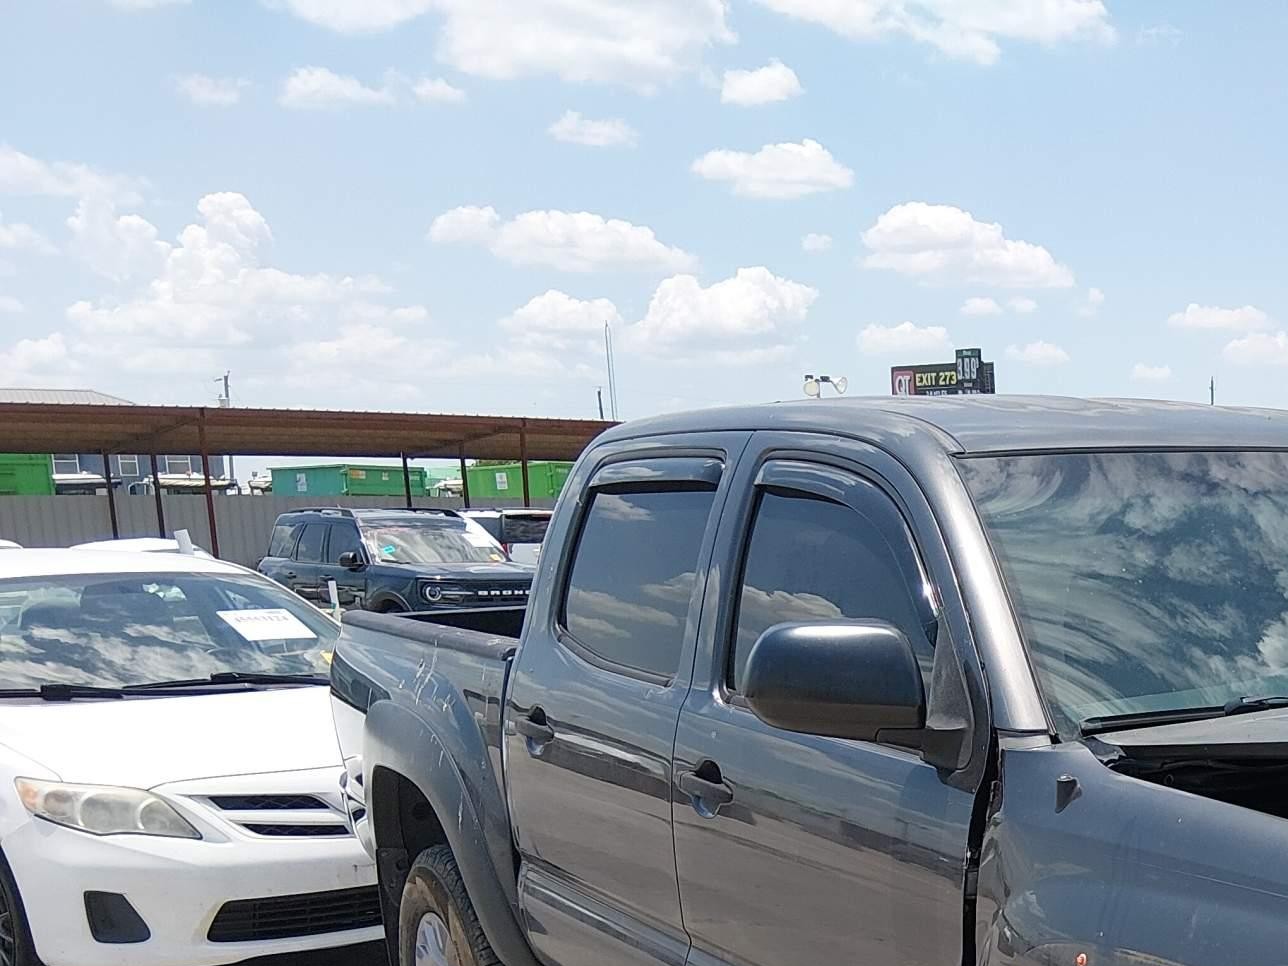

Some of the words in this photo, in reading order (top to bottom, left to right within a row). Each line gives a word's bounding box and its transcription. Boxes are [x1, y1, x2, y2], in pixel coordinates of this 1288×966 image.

[896, 376, 911, 396] QT
[915, 372, 937, 386] EXIT
[938, 371, 957, 385] 273
